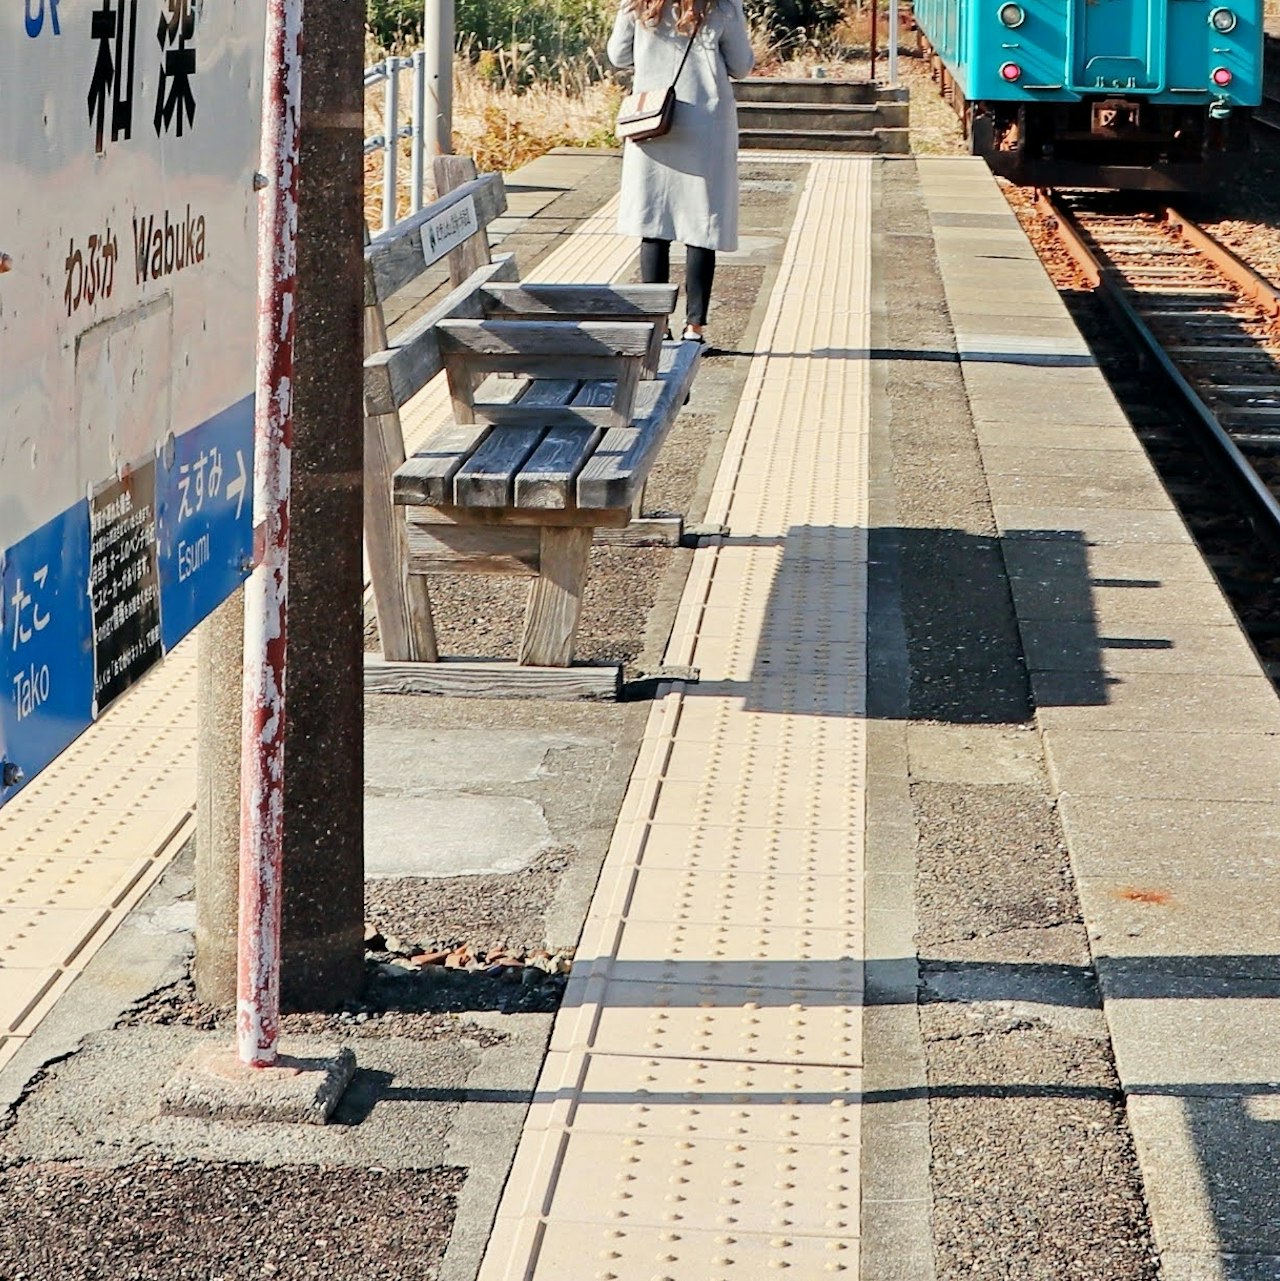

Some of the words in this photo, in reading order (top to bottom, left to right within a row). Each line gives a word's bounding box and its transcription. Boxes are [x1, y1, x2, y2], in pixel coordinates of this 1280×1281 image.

[64, 227, 118, 317] わぶか
[132, 203, 206, 286] Wabuka
[178, 446, 223, 523] えすみ
[178, 532, 210, 583] Esumi
[11, 564, 51, 652] たこ
[12, 662, 50, 721] Tako
